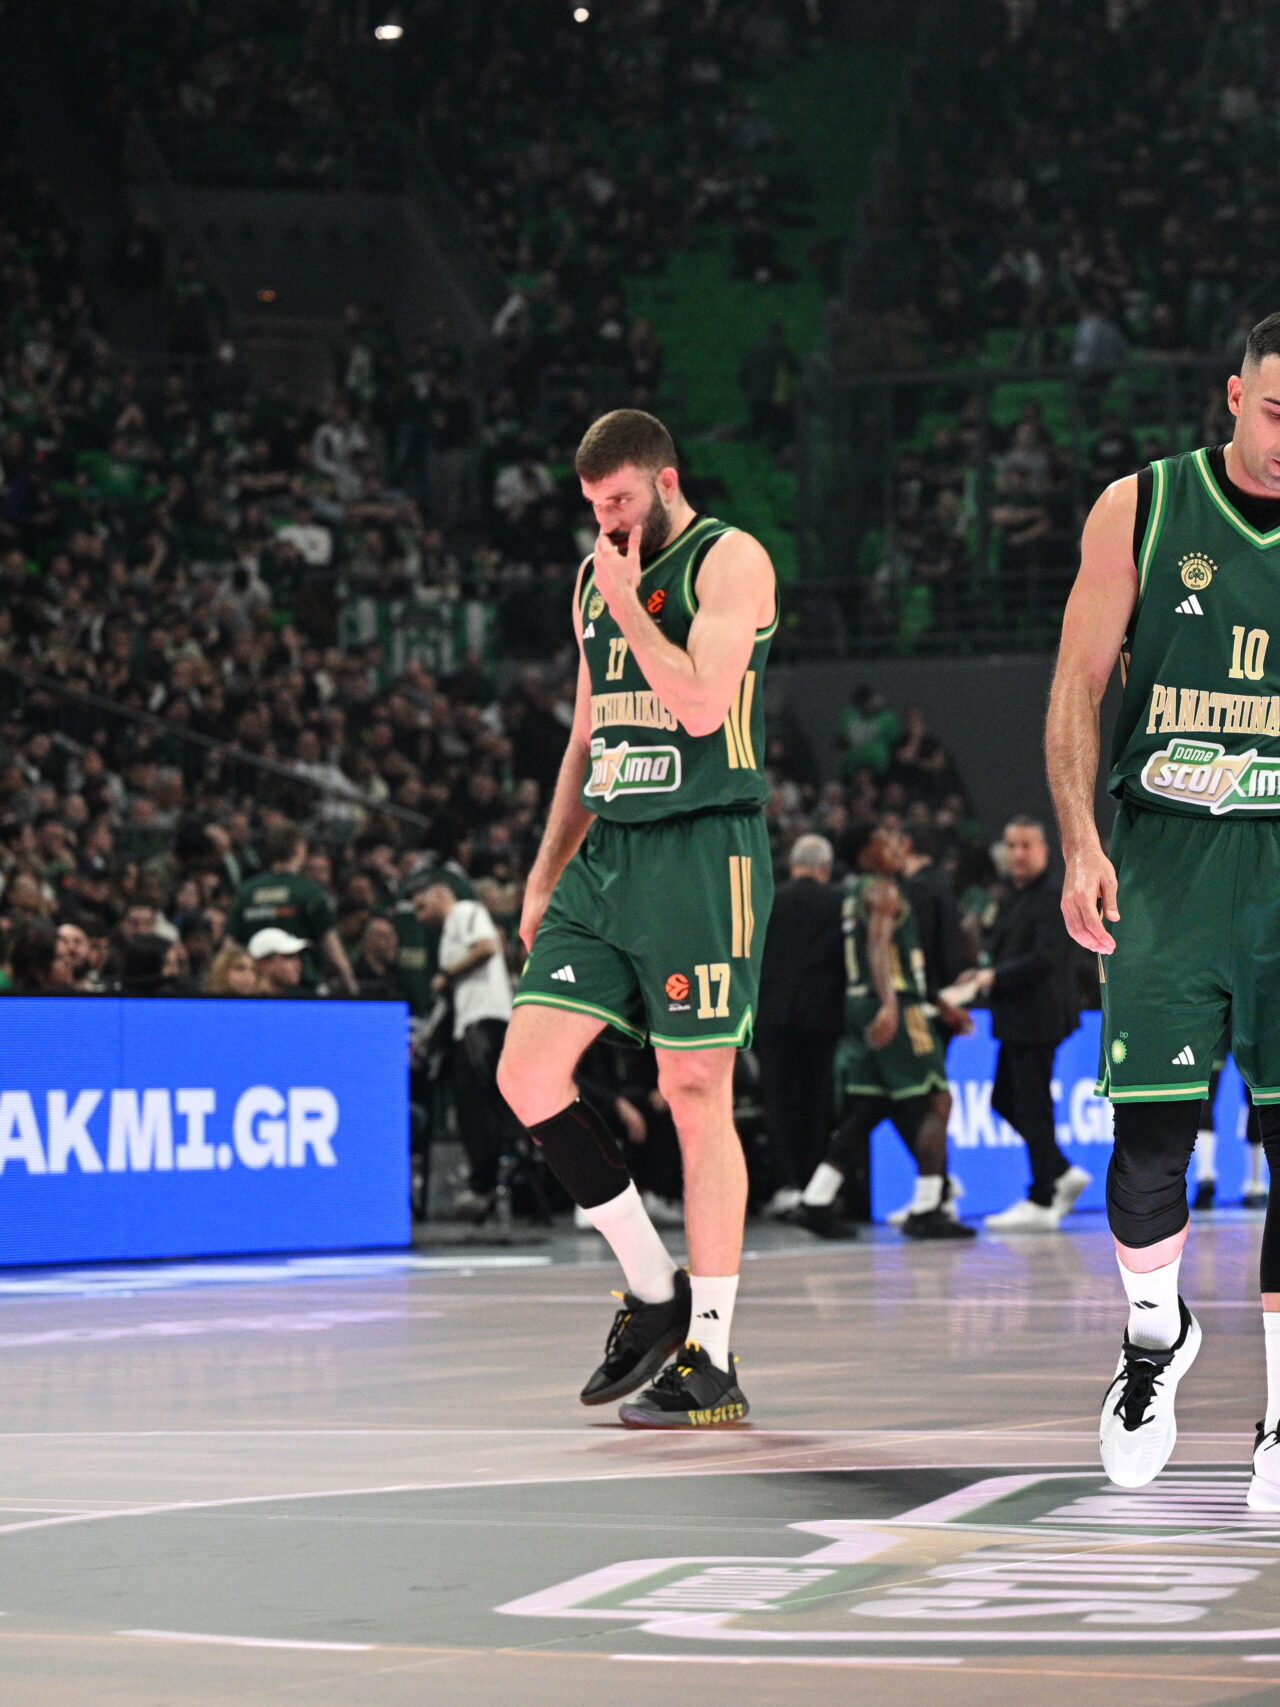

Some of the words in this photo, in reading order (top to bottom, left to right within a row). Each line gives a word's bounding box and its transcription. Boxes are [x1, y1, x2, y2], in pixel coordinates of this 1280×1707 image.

[605, 637, 629, 681] 17
[1229, 625, 1270, 681] 10
[1172, 746, 1215, 762] pame
[694, 963, 731, 1020] 17
[1119, 1030, 1129, 1039] bp
[0, 1085, 339, 1174] AKMI.GR
